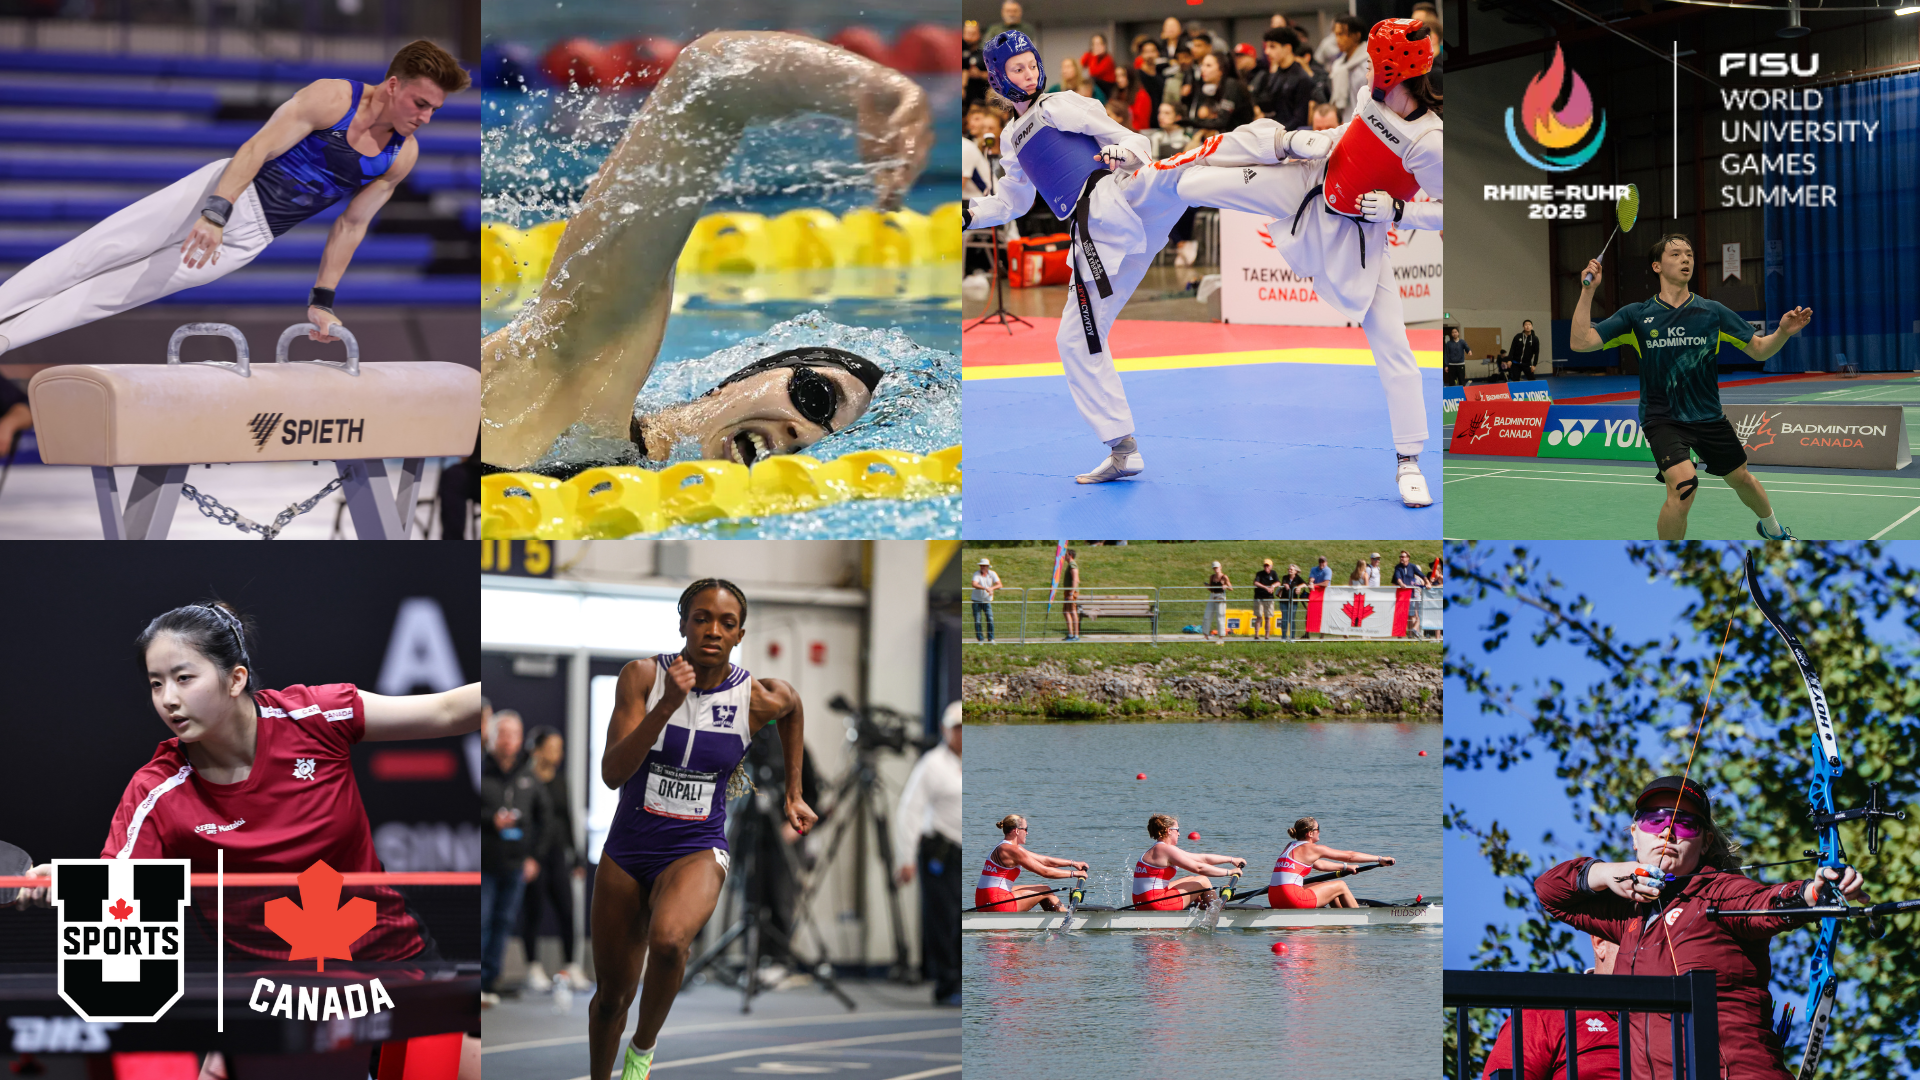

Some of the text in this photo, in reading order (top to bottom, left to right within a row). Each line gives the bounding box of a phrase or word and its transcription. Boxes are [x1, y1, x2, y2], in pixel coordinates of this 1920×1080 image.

[1014, 122, 1034, 148] KPNP
[1367, 114, 1400, 145] KPNP
[1258, 287, 1319, 302] CANADA
[1667, 326, 1686, 337] KC
[1645, 336, 1707, 348] BADMINTON
[1486, 393, 1510, 401] BADMINTON
[1493, 416, 1542, 427] BADMINTON
[281, 418, 365, 445] SPIETH
[1498, 429, 1532, 438] CANADA
[1781, 422, 1888, 437] BADMINTON
[1799, 437, 1864, 448] CANADA
[658, 778, 703, 801] OKPALI
[1391, 908, 1427, 917] HUDSON
